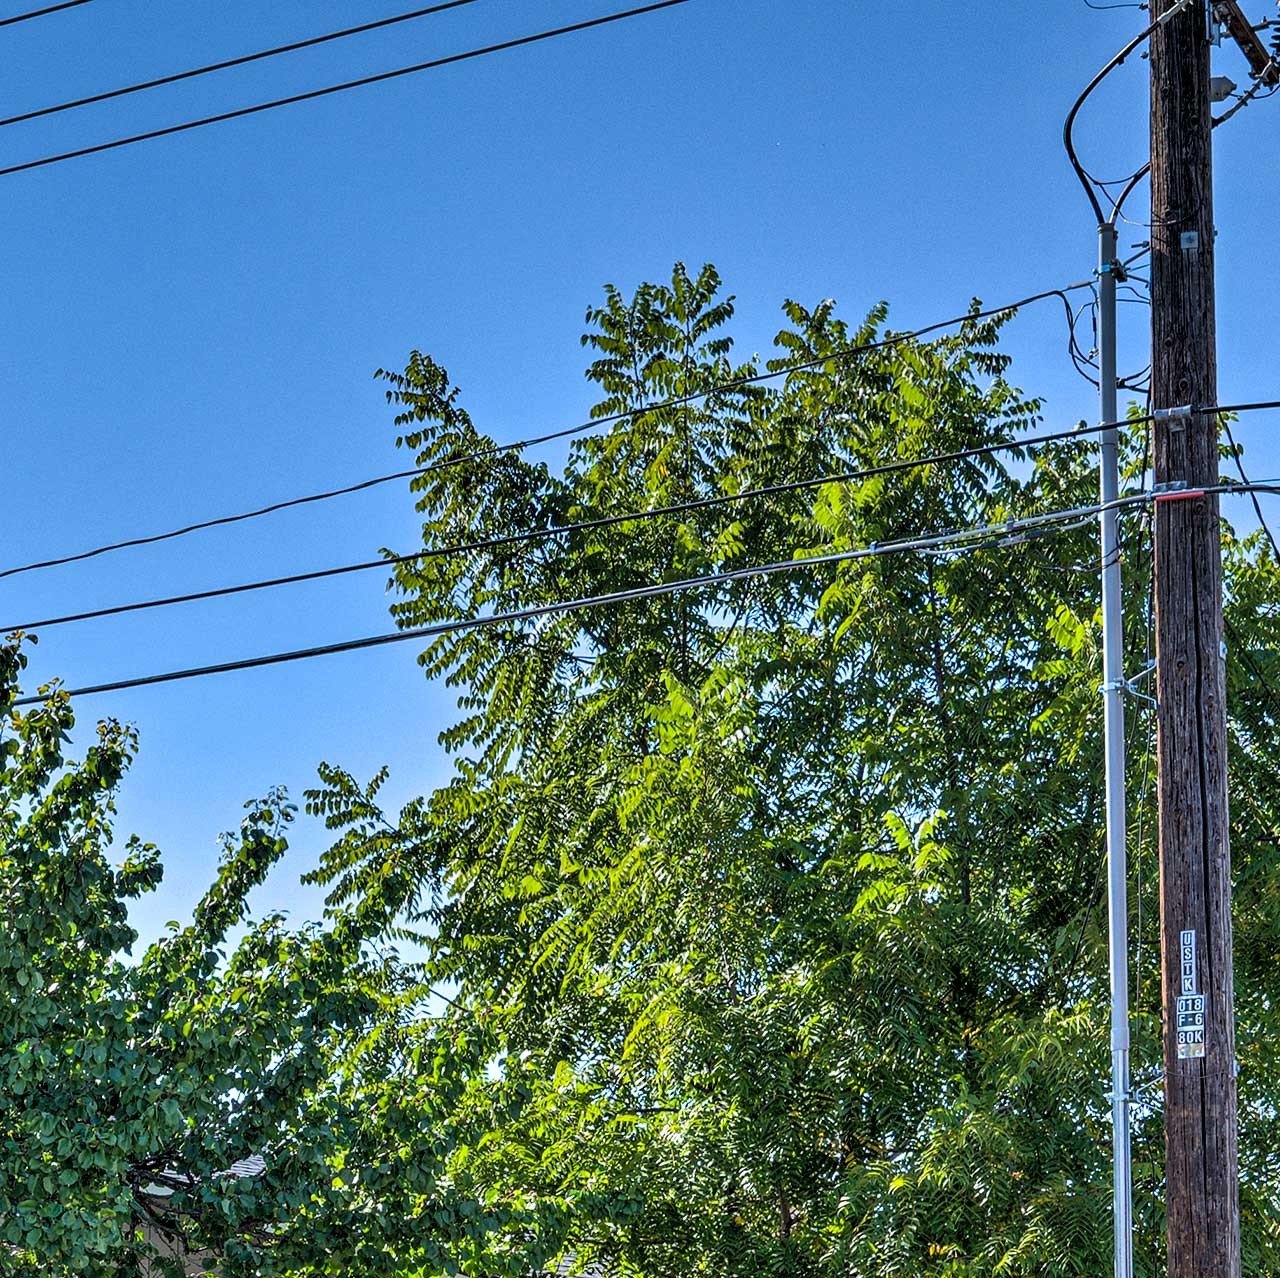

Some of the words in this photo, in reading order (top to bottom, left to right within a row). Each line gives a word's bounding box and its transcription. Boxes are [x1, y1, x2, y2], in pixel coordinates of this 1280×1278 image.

[1179, 999, 1202, 1012] 018
[1178, 1014, 1203, 1026] F-6
[1178, 1031, 1203, 1043] 80K
